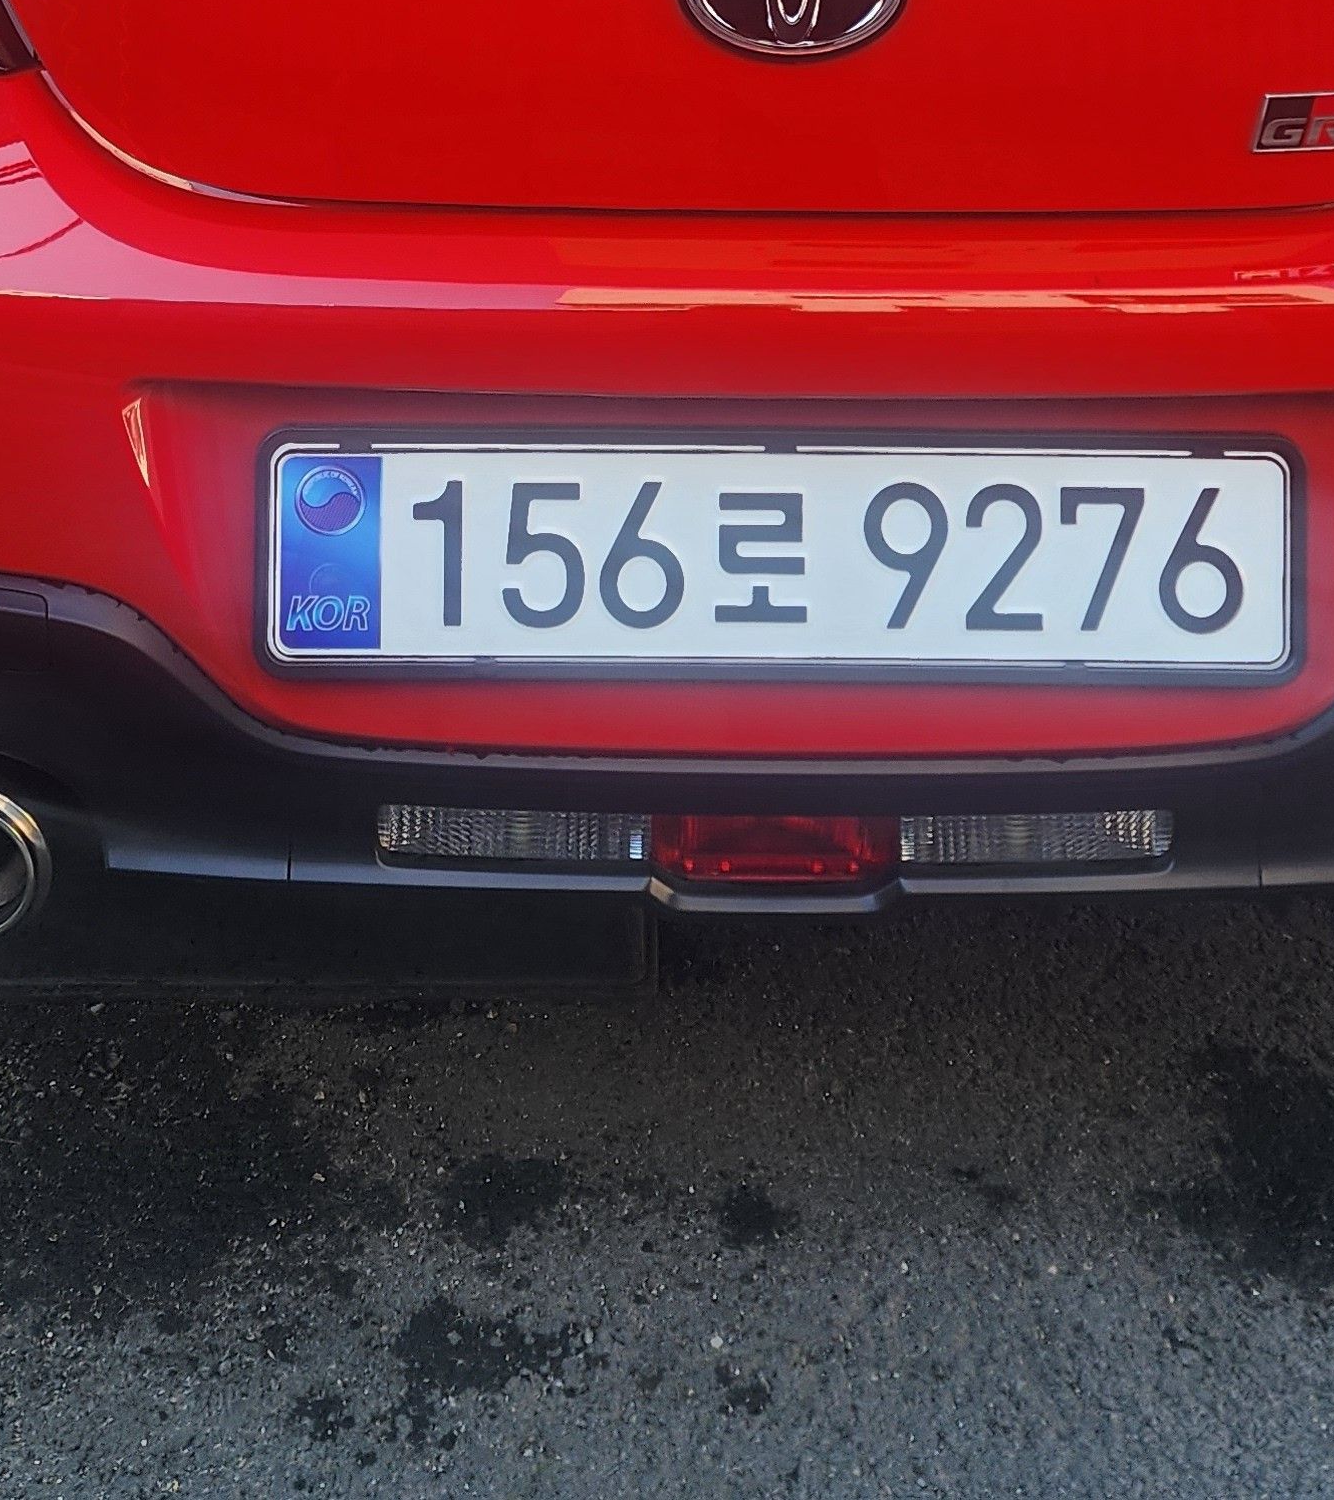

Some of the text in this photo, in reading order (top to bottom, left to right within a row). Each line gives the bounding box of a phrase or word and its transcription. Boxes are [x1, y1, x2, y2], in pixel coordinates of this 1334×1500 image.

[412, 478, 1245, 635] 156로 9276
[285, 595, 371, 632] KOR
